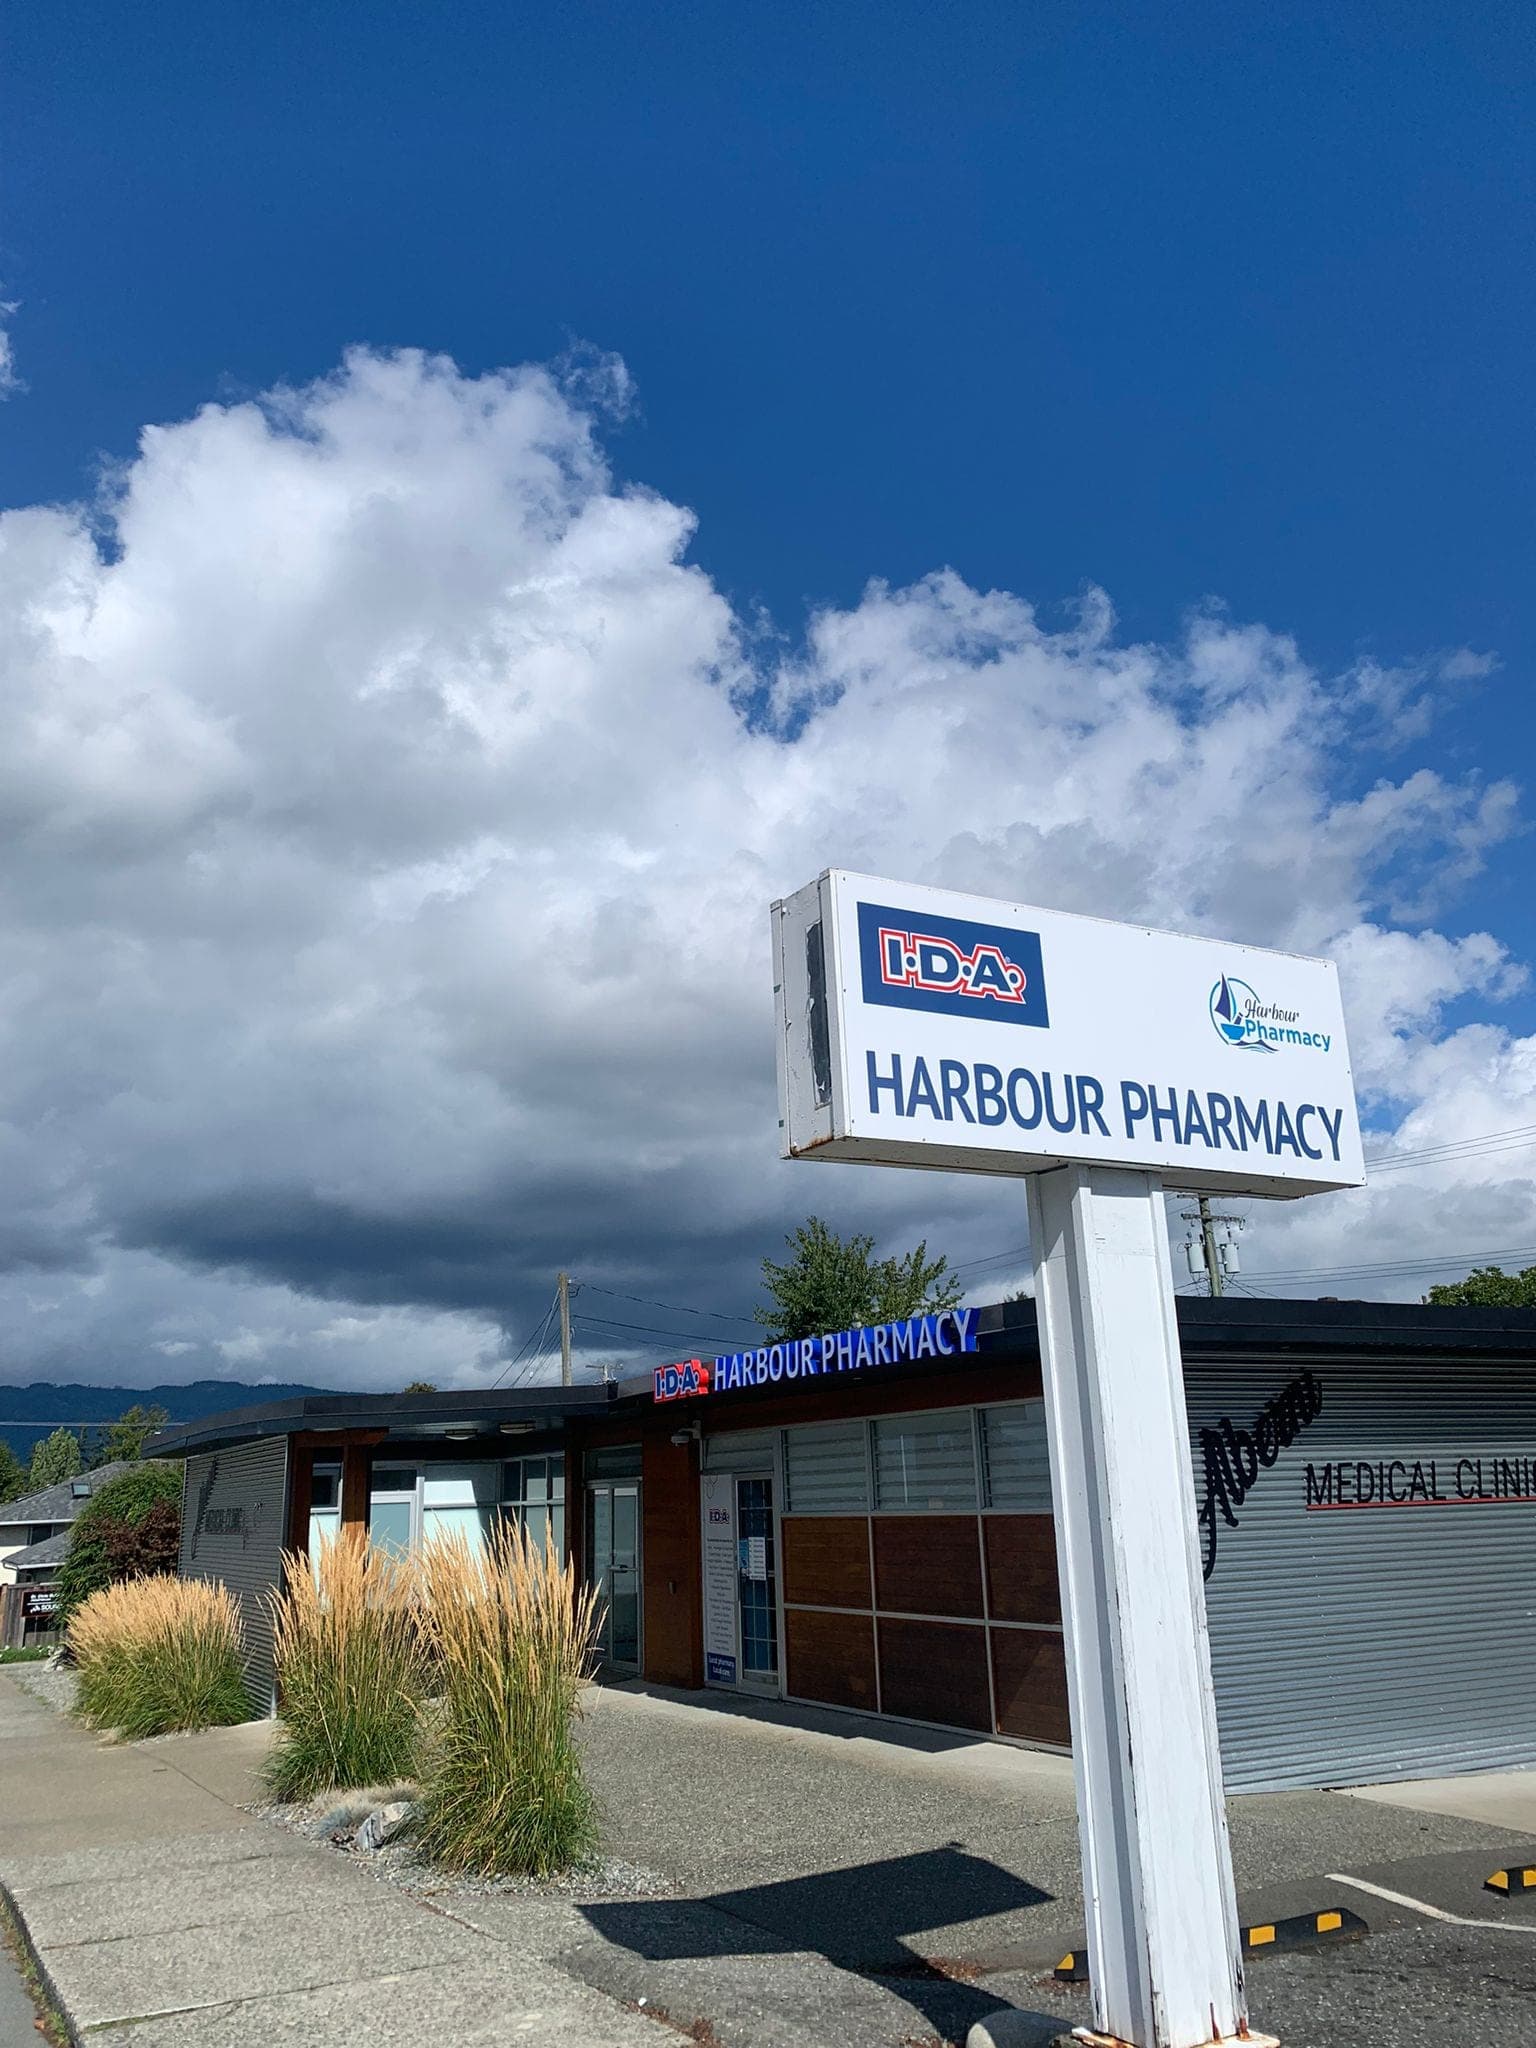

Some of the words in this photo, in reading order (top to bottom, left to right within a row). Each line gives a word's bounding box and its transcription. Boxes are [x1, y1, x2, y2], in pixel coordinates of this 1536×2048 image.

[1244, 998, 1300, 1023] Harbour
[1244, 1019, 1331, 1052] Pharmacy
[866, 1050, 1109, 1137] HARBOUR
[1121, 1081, 1343, 1162] PHARMACY
[713, 1339, 818, 1392] HARBOUR
[821, 1309, 973, 1373] PHARMACY
[1306, 1460, 1447, 1505] MEDICAL
[1455, 1458, 1536, 1498] CLINI
